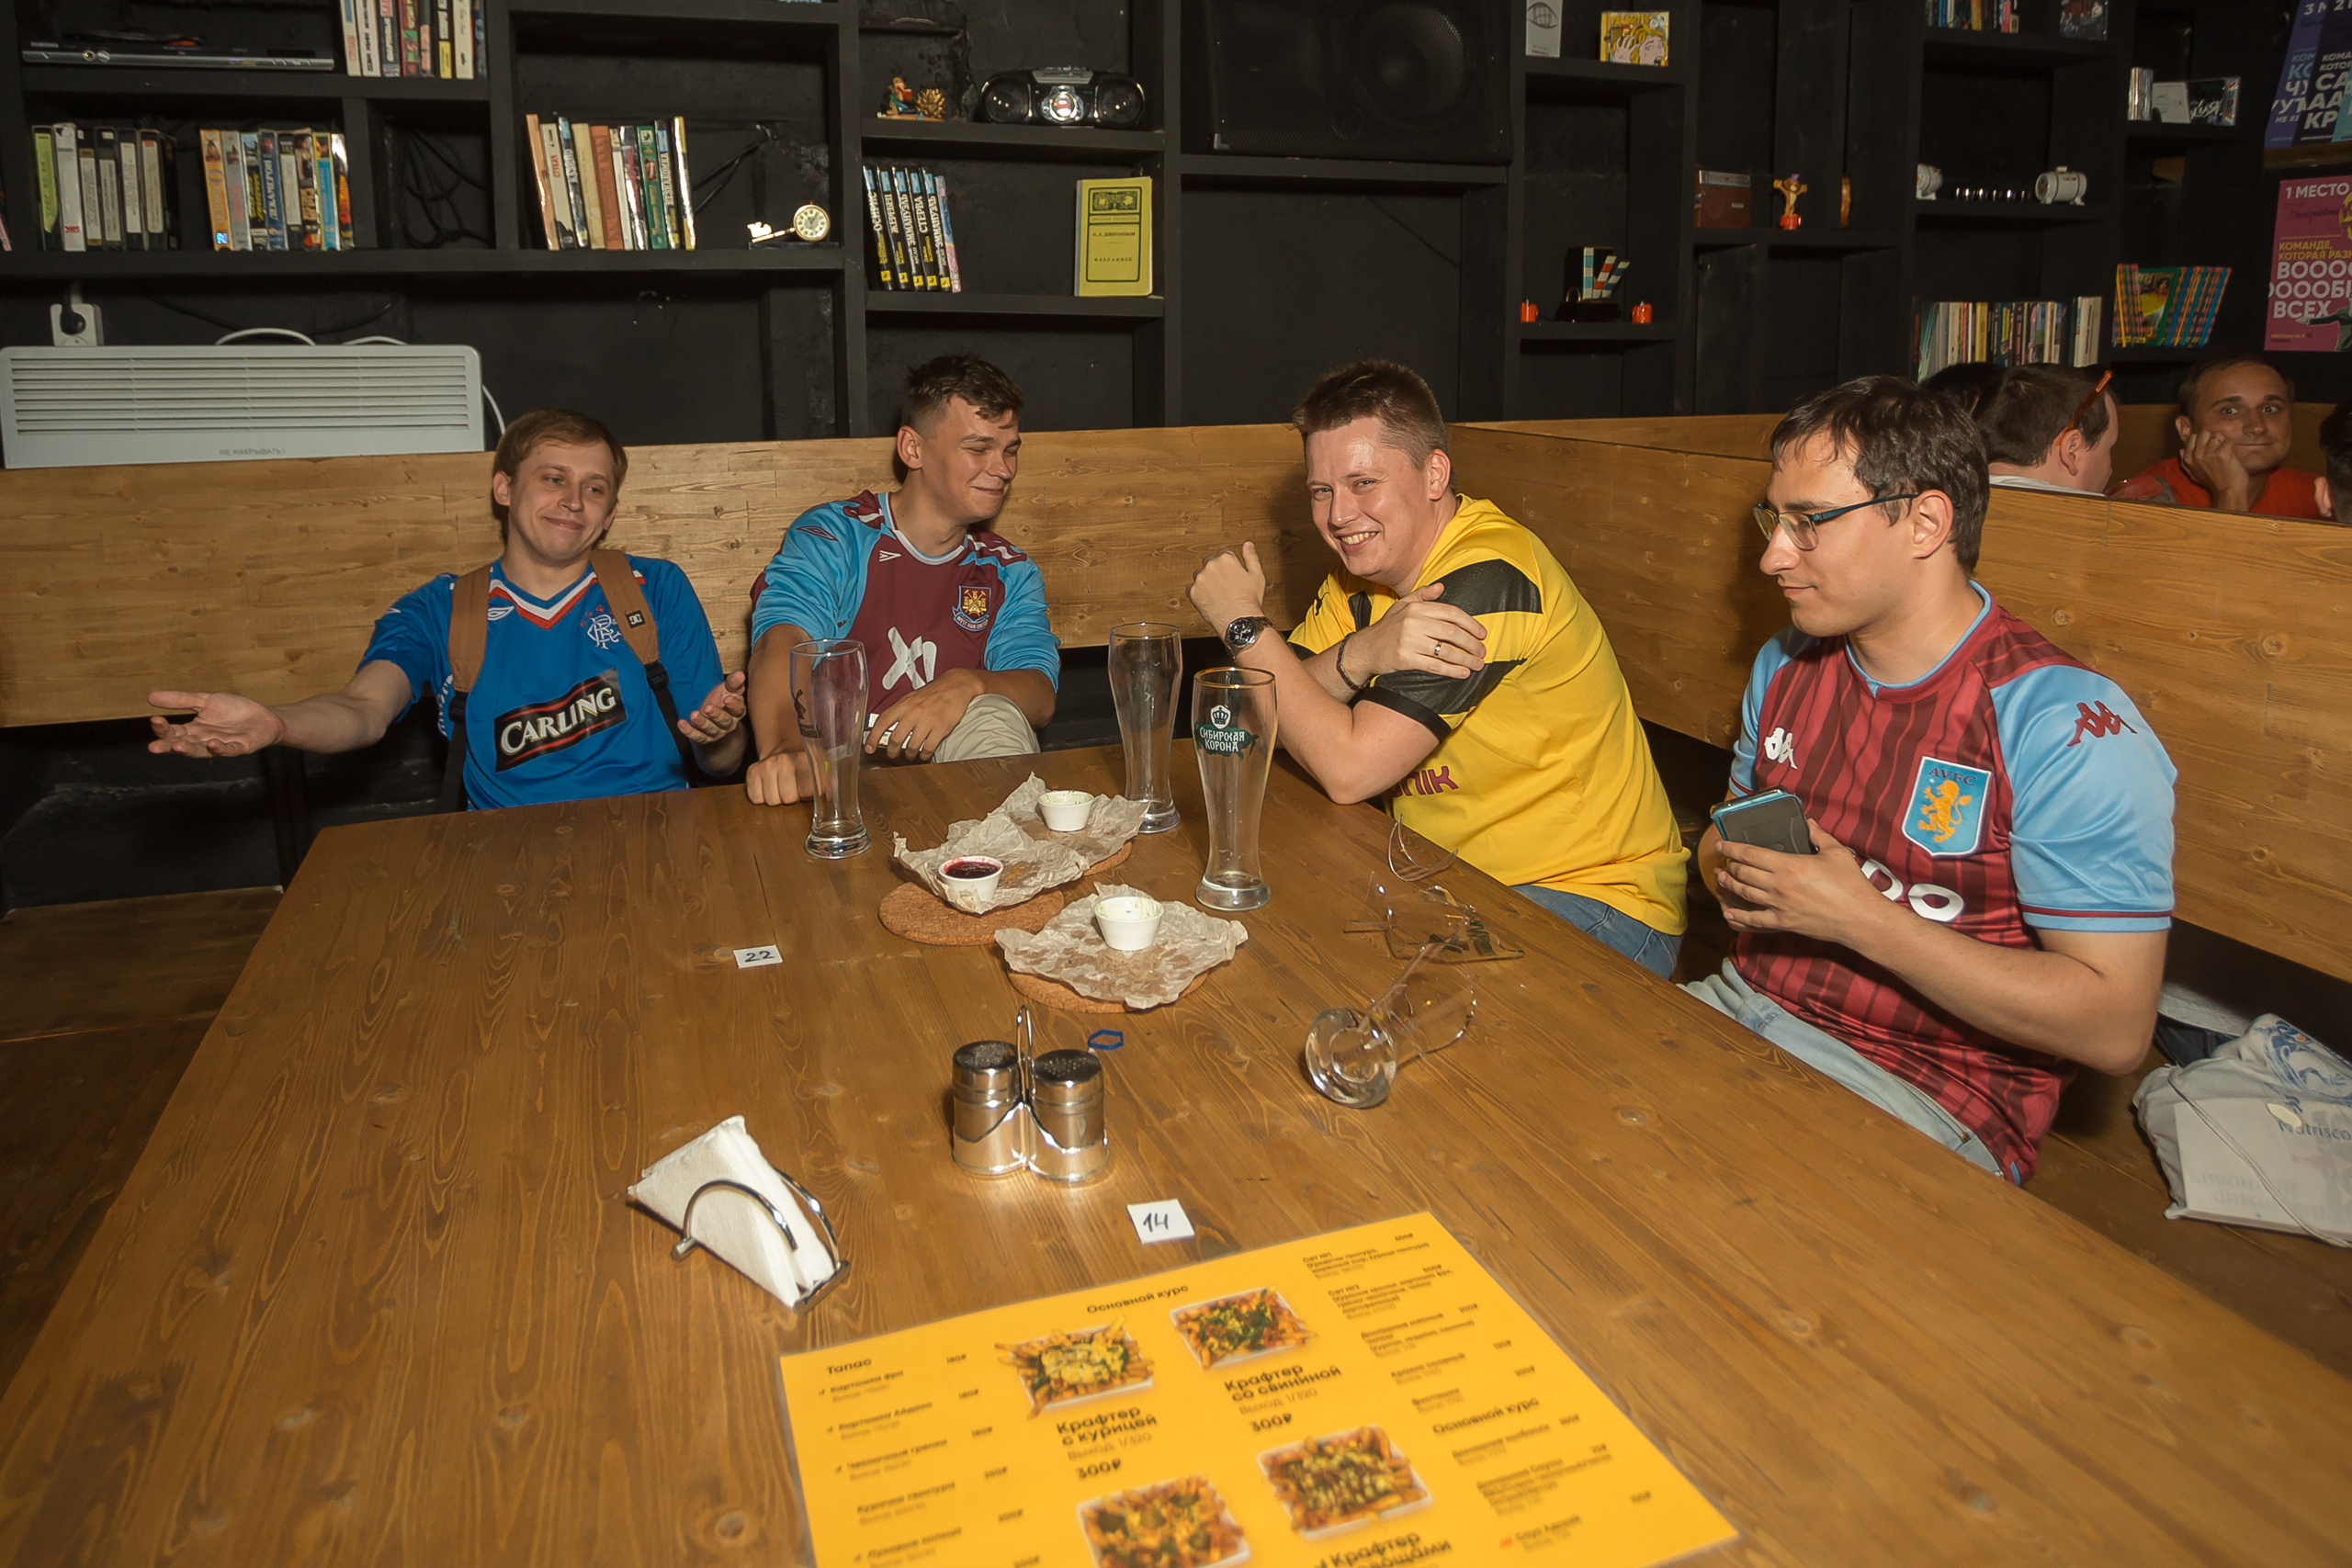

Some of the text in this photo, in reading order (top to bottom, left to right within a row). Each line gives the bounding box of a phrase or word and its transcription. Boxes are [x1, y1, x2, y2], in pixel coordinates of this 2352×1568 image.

[2285, 183, 2350, 198] 1 МЕСТО
[867, 191, 883, 231] ОСИРИС
[884, 193, 899, 234] ЖЕРЕБЕЦ
[899, 193, 917, 247] ЭММАНУЭЛЬ
[913, 195, 929, 233] СТЕРВА
[928, 195, 944, 249] ЭММАНУЭЛЬ
[2278, 241, 2334, 252] КОМАНДЕ,
[2278, 251, 2326, 261] КОТОРАЯ
[2277, 260, 2352, 279] ВООО
[2273, 300, 2332, 320] ВСЕХ
[501, 687, 616, 756] CARLING
[1204, 739, 1238, 752] КОРОНА
[1927, 767, 1977, 786] AVFC
[745, 951, 775, 962] 22
[1143, 1213, 1169, 1233] 14
[1302, 1254, 1318, 1263] Сет
[1087, 1285, 1189, 1313] Основной курс
[1328, 1288, 1344, 1297] Сет
[826, 1359, 873, 1374] Тапас
[830, 1370, 904, 1393] Картошка фри
[1224, 1365, 1303, 1392] Крафтер
[1232, 1365, 1341, 1402] со свининой
[838, 1402, 933, 1430] Картошка Айдахо
[1057, 1407, 1141, 1434] Крафтер
[1250, 1413, 1292, 1432] 300₽
[1432, 1398, 1540, 1435] Основной курс
[1062, 1414, 1158, 1446] с курицей
[847, 1450, 909, 1470] Чесночные
[910, 1438, 947, 1454] гренки
[1076, 1459, 1121, 1479] 300₽
[856, 1495, 904, 1514] Курочка
[1329, 1532, 1419, 1567] Крафтер
